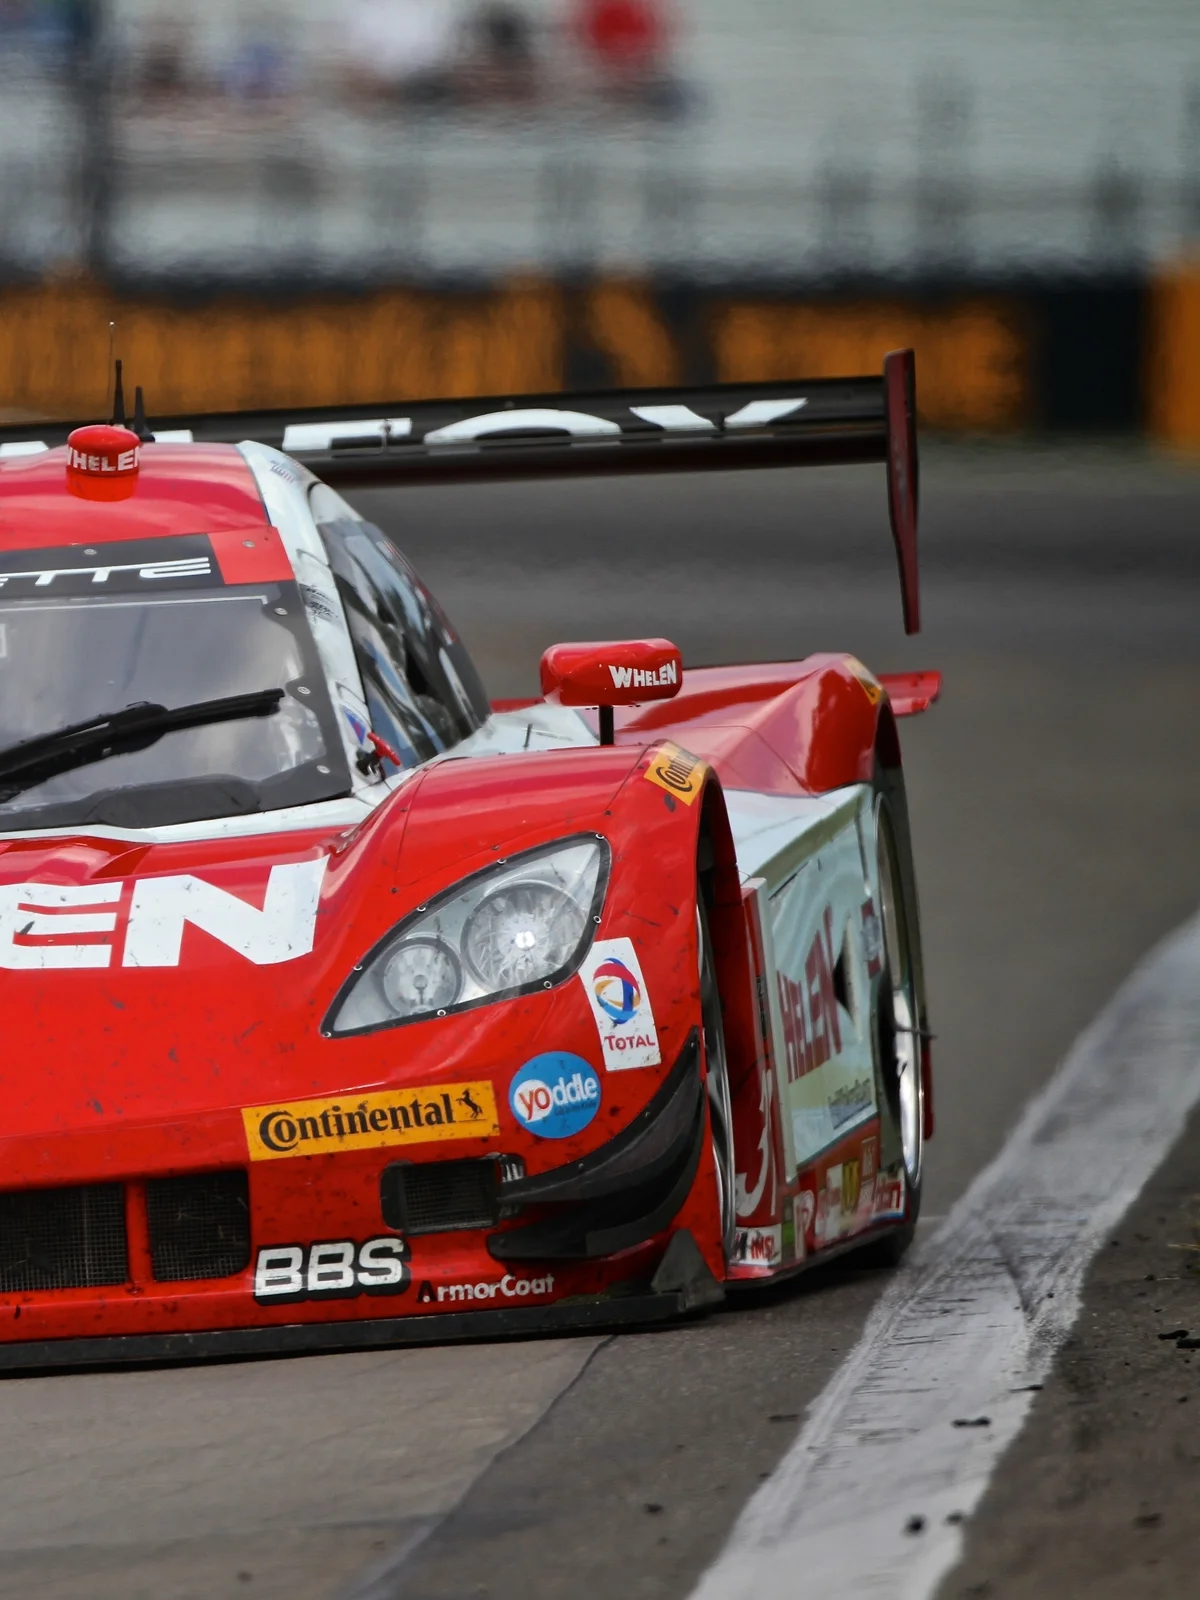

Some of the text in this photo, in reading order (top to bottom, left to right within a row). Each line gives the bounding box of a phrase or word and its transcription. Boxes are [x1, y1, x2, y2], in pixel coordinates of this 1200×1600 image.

[608, 659, 677, 688] WHELEN
[259, 1093, 456, 1152] Continental
[518, 1073, 597, 1120] yoddle
[255, 1238, 405, 1297] BBS
